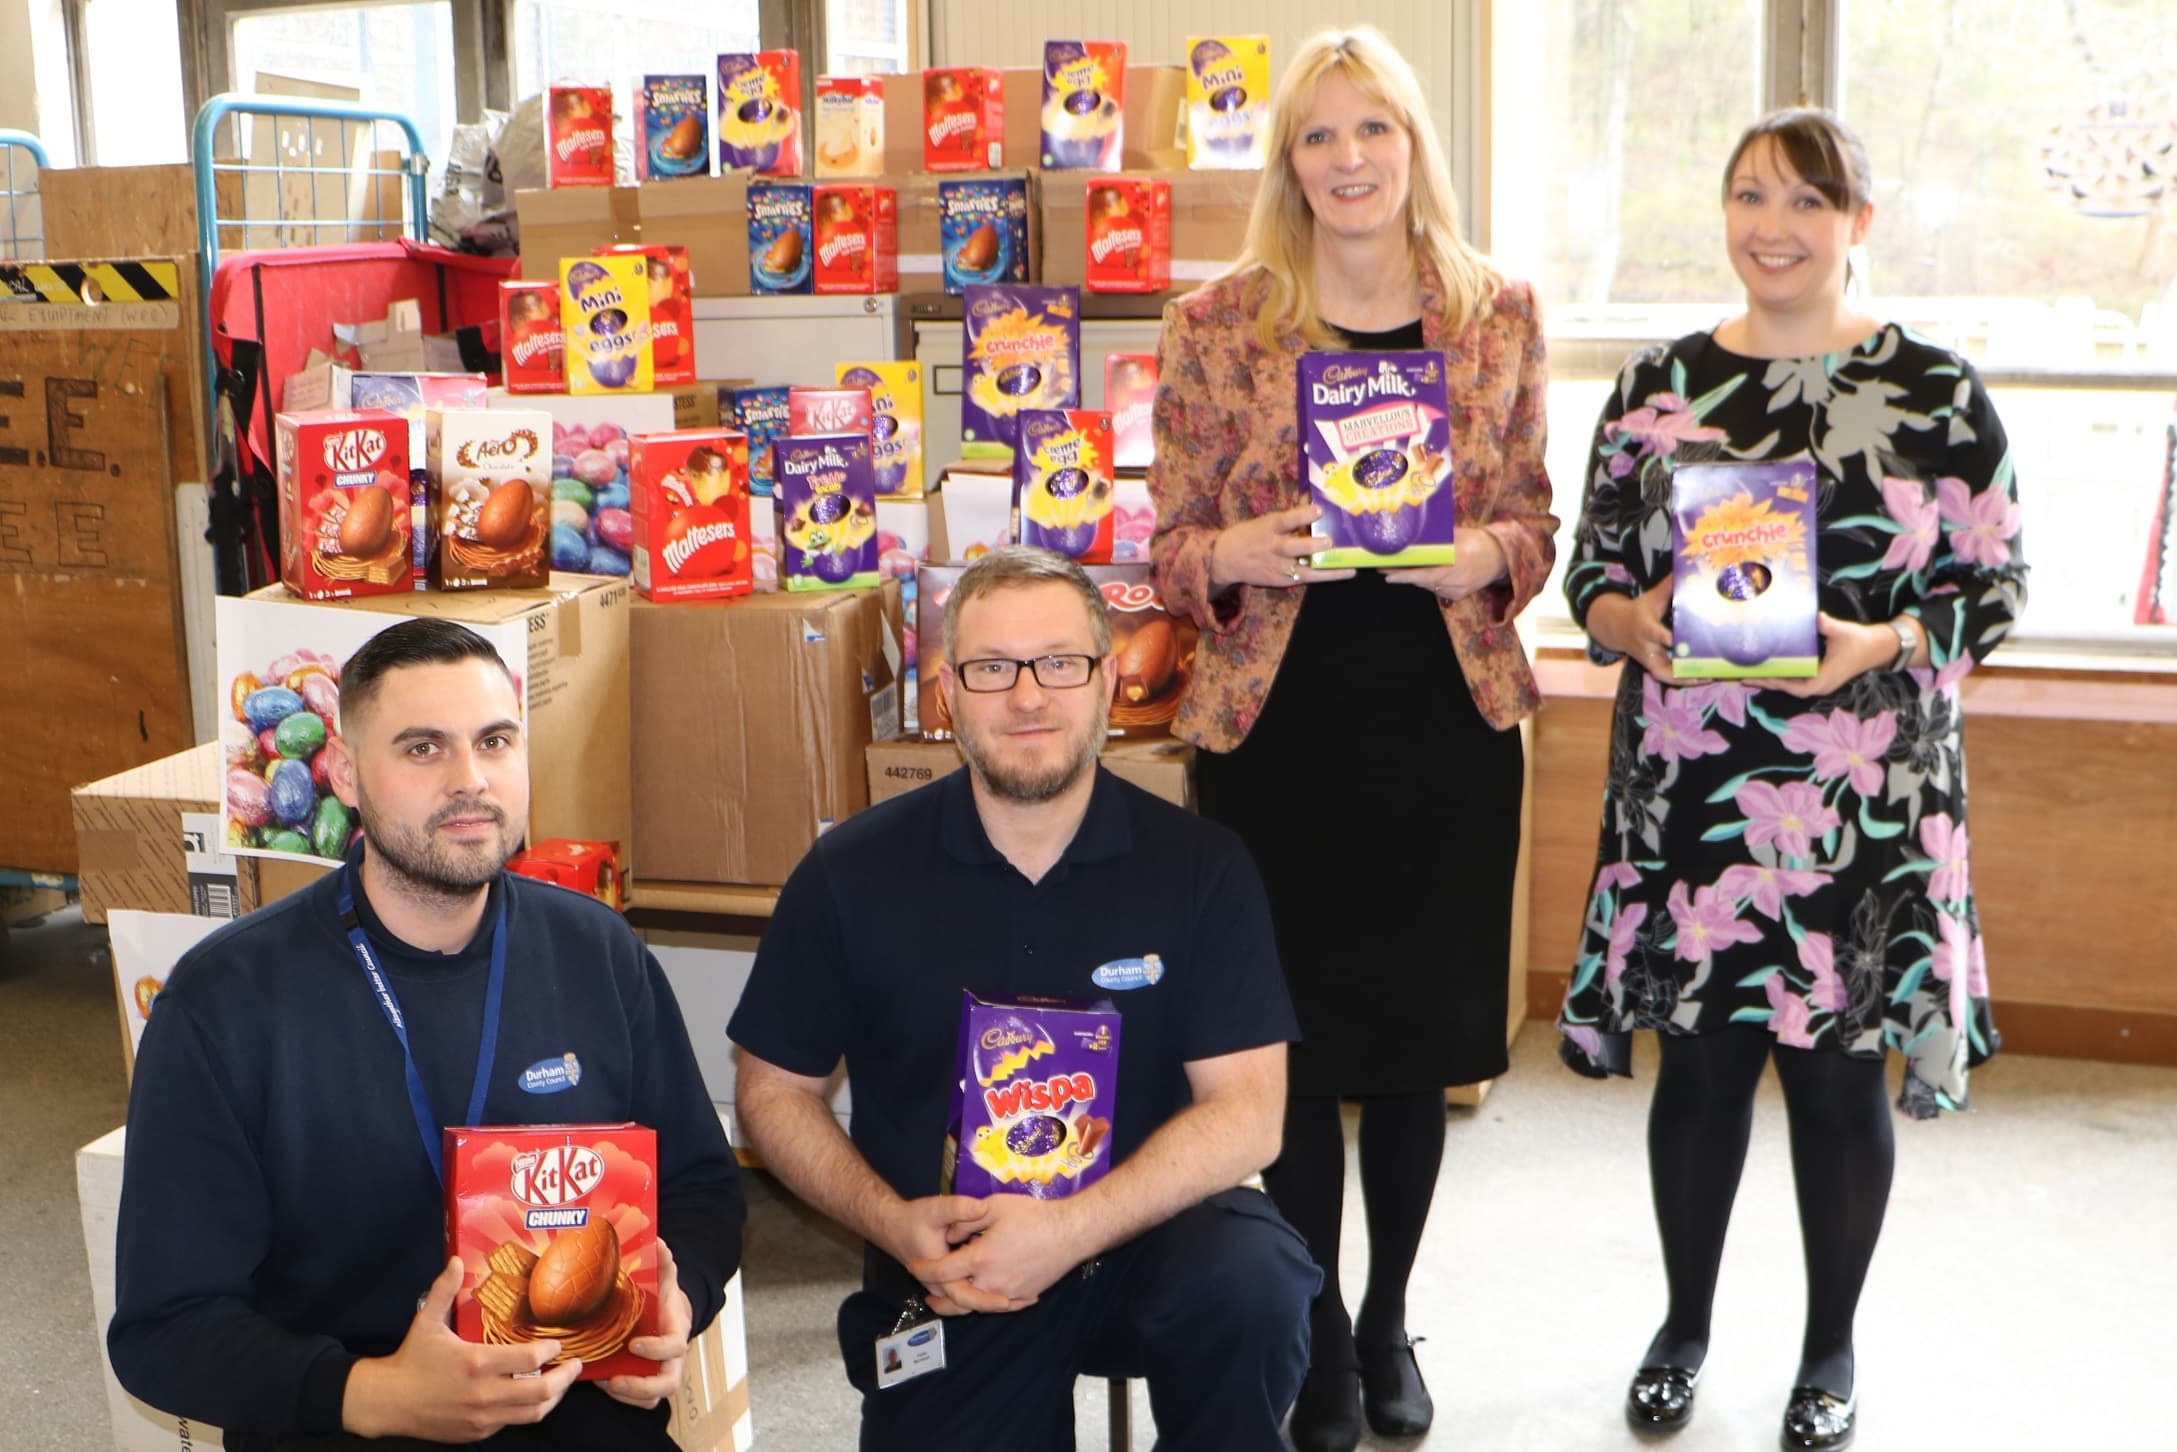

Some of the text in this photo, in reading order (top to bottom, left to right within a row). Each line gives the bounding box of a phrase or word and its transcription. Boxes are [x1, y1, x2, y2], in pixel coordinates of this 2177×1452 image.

[1202, 66, 1243, 90] Mini
[652, 89, 702, 107] Smarties
[928, 112, 977, 147] Maltesers
[557, 128, 606, 162] Maltesers
[755, 201, 803, 220] Smarties
[948, 196, 999, 216] Smarties
[819, 232, 866, 267] Maltesers
[1091, 229, 1142, 264] Maltesers
[581, 287, 623, 312] Mini
[512, 332, 566, 367] Maltesers
[590, 333, 632, 352] eggs
[1323, 364, 1368, 385] Cadbury
[1312, 372, 1417, 406] Dairy Milk
[744, 404, 791, 426] Smartie
[1343, 407, 1411, 432] MARVELLOUS
[1345, 421, 1415, 444] CREATIONS
[331, 430, 383, 471] KitKat
[873, 441, 903, 458] ggs
[1043, 438, 1080, 455] creme
[784, 451, 849, 475] Dairy Milk
[335, 472, 375, 486] CHUNKY
[1701, 524, 1788, 549] crunchie
[662, 522, 737, 575] Maltesers
[884, 765, 933, 781] 442769
[356, 943, 376, 971] Council
[1100, 965, 1142, 977] Durham
[981, 1028, 1033, 1050] Cadbury
[526, 1066, 564, 1082] Durham
[527, 1075, 566, 1089] County Council
[524, 1148, 599, 1205] KitKat
[527, 1209, 586, 1228] CHUNKY
